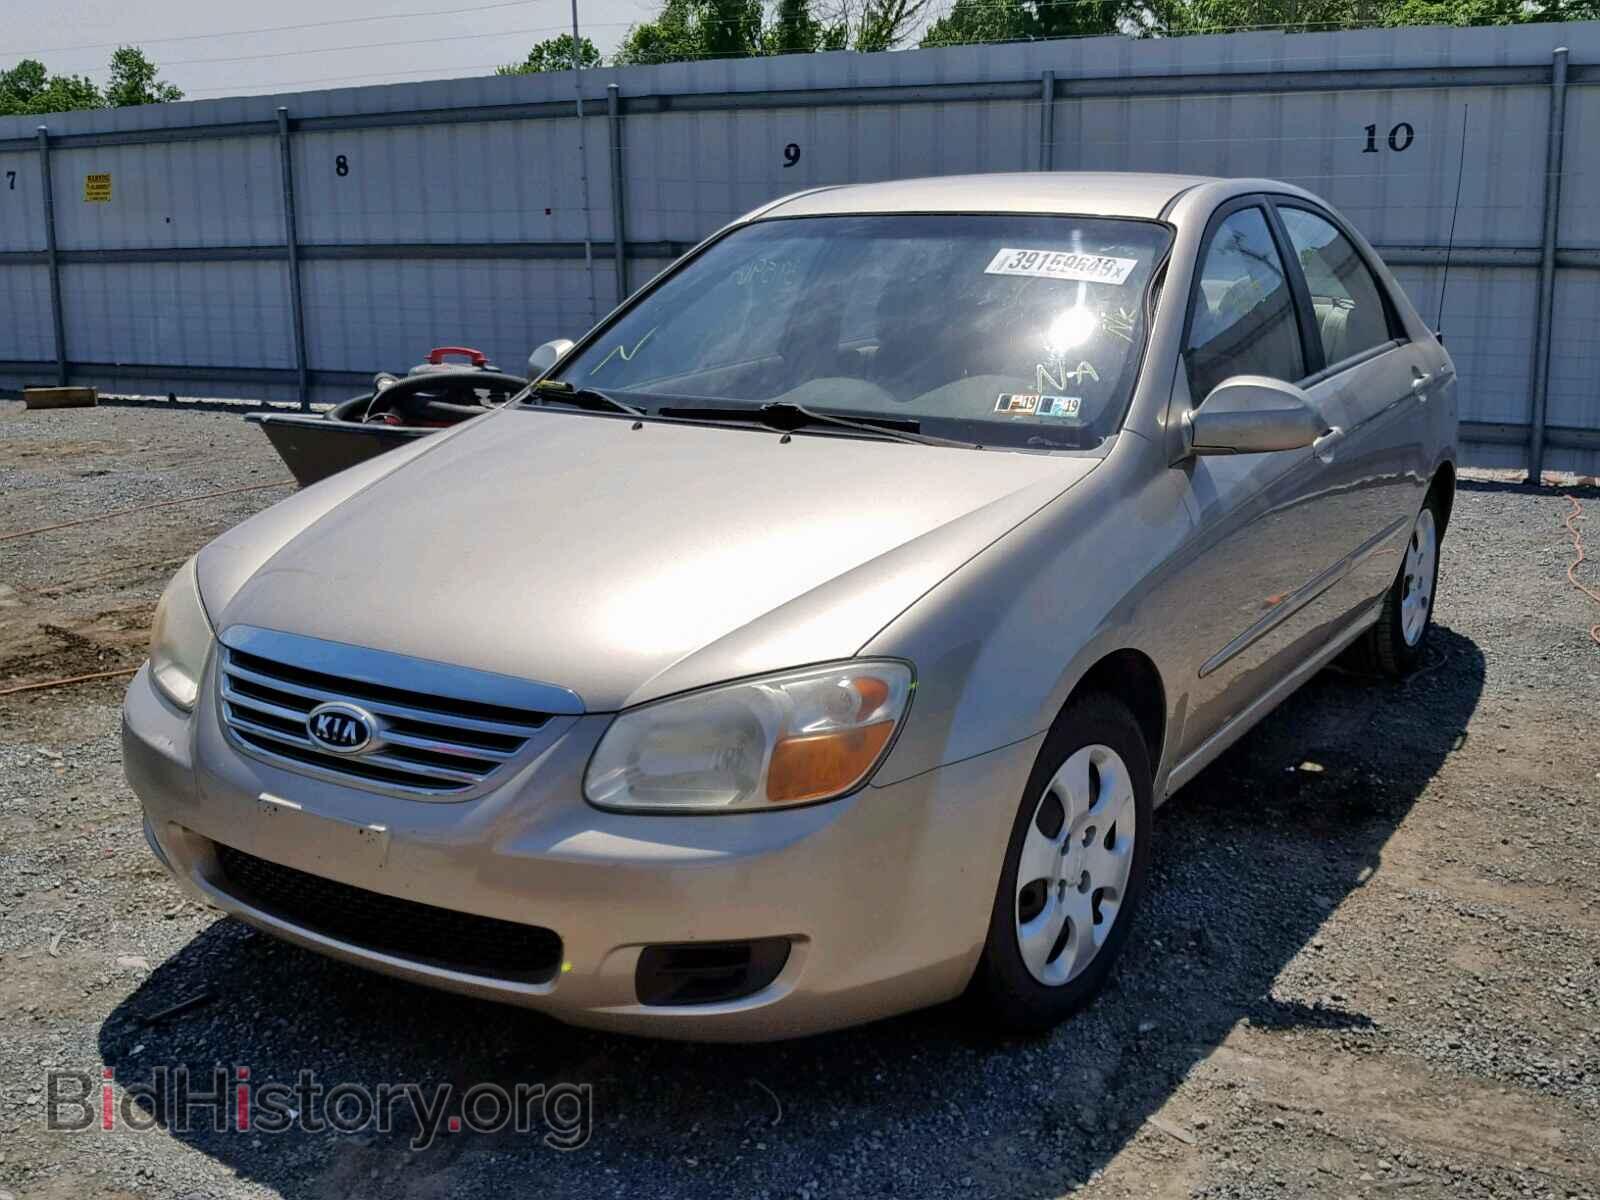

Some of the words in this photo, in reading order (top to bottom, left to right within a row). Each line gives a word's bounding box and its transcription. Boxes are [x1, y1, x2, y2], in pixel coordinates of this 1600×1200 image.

[1363, 122, 1415, 153] 10
[335, 155, 349, 177] 8
[783, 143, 801, 168] 9
[6, 171, 17, 190] 7
[315, 714, 358, 745] KIA
